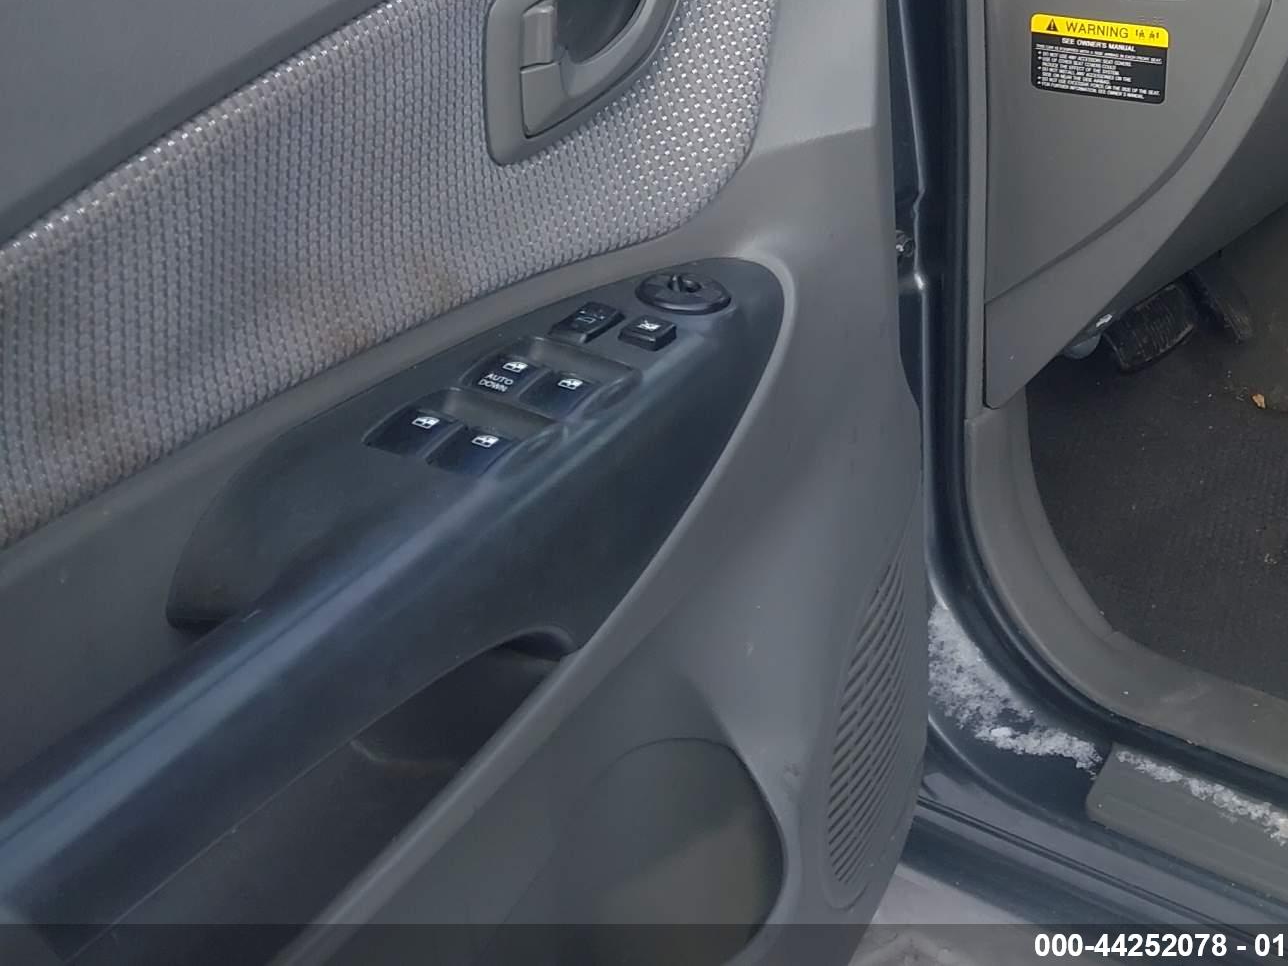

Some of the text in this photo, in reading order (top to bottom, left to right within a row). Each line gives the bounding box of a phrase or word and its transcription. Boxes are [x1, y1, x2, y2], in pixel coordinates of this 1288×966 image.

[1066, 21, 1129, 39] WARNING
[1077, 39, 1107, 48] OWNER'S
[1108, 43, 1136, 51] MANUAL
[484, 373, 514, 385] AUTO
[478, 379, 508, 392] DOWN
